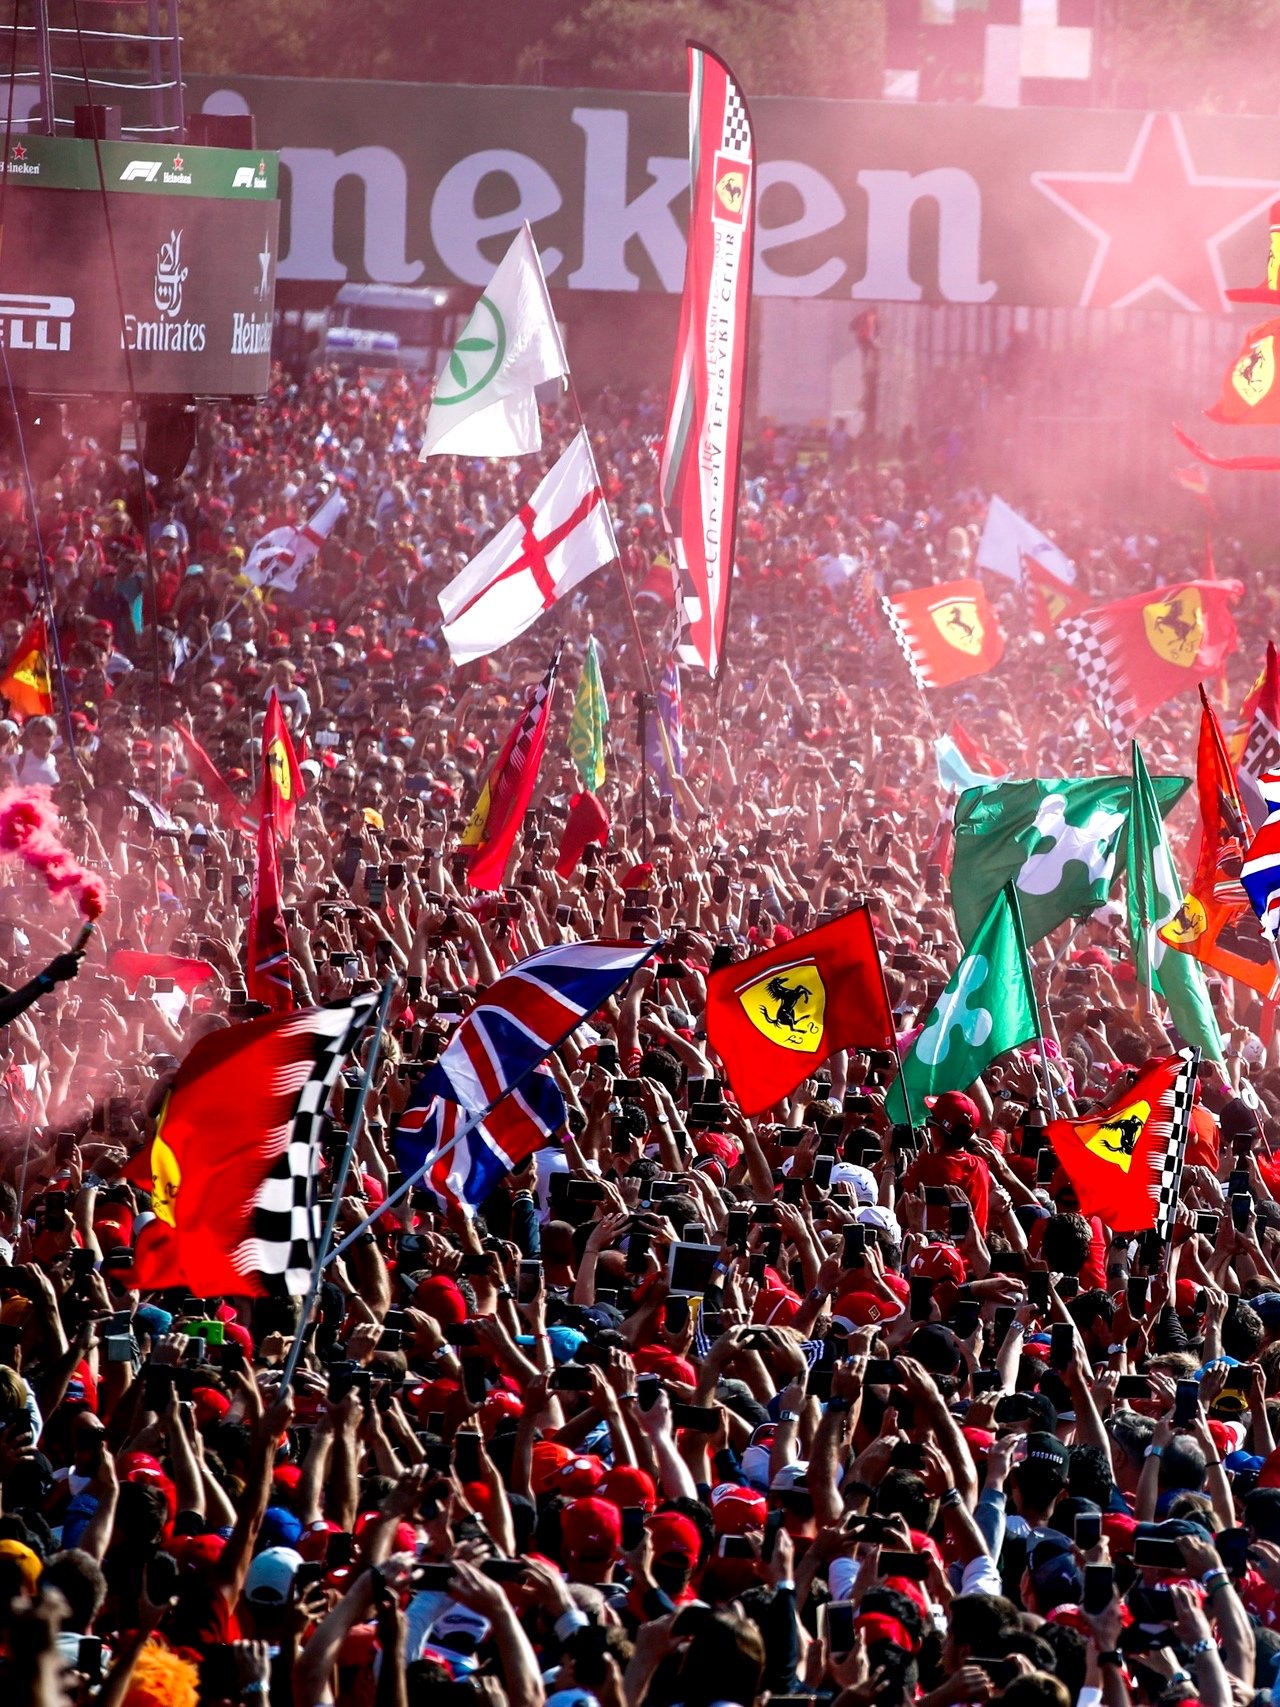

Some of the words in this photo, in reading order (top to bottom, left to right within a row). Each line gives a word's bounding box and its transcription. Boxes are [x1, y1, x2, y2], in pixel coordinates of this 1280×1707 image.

[200, 89, 998, 303] neken
[120, 314, 206, 352] Emirates
[1241, 716, 1280, 777] ER
